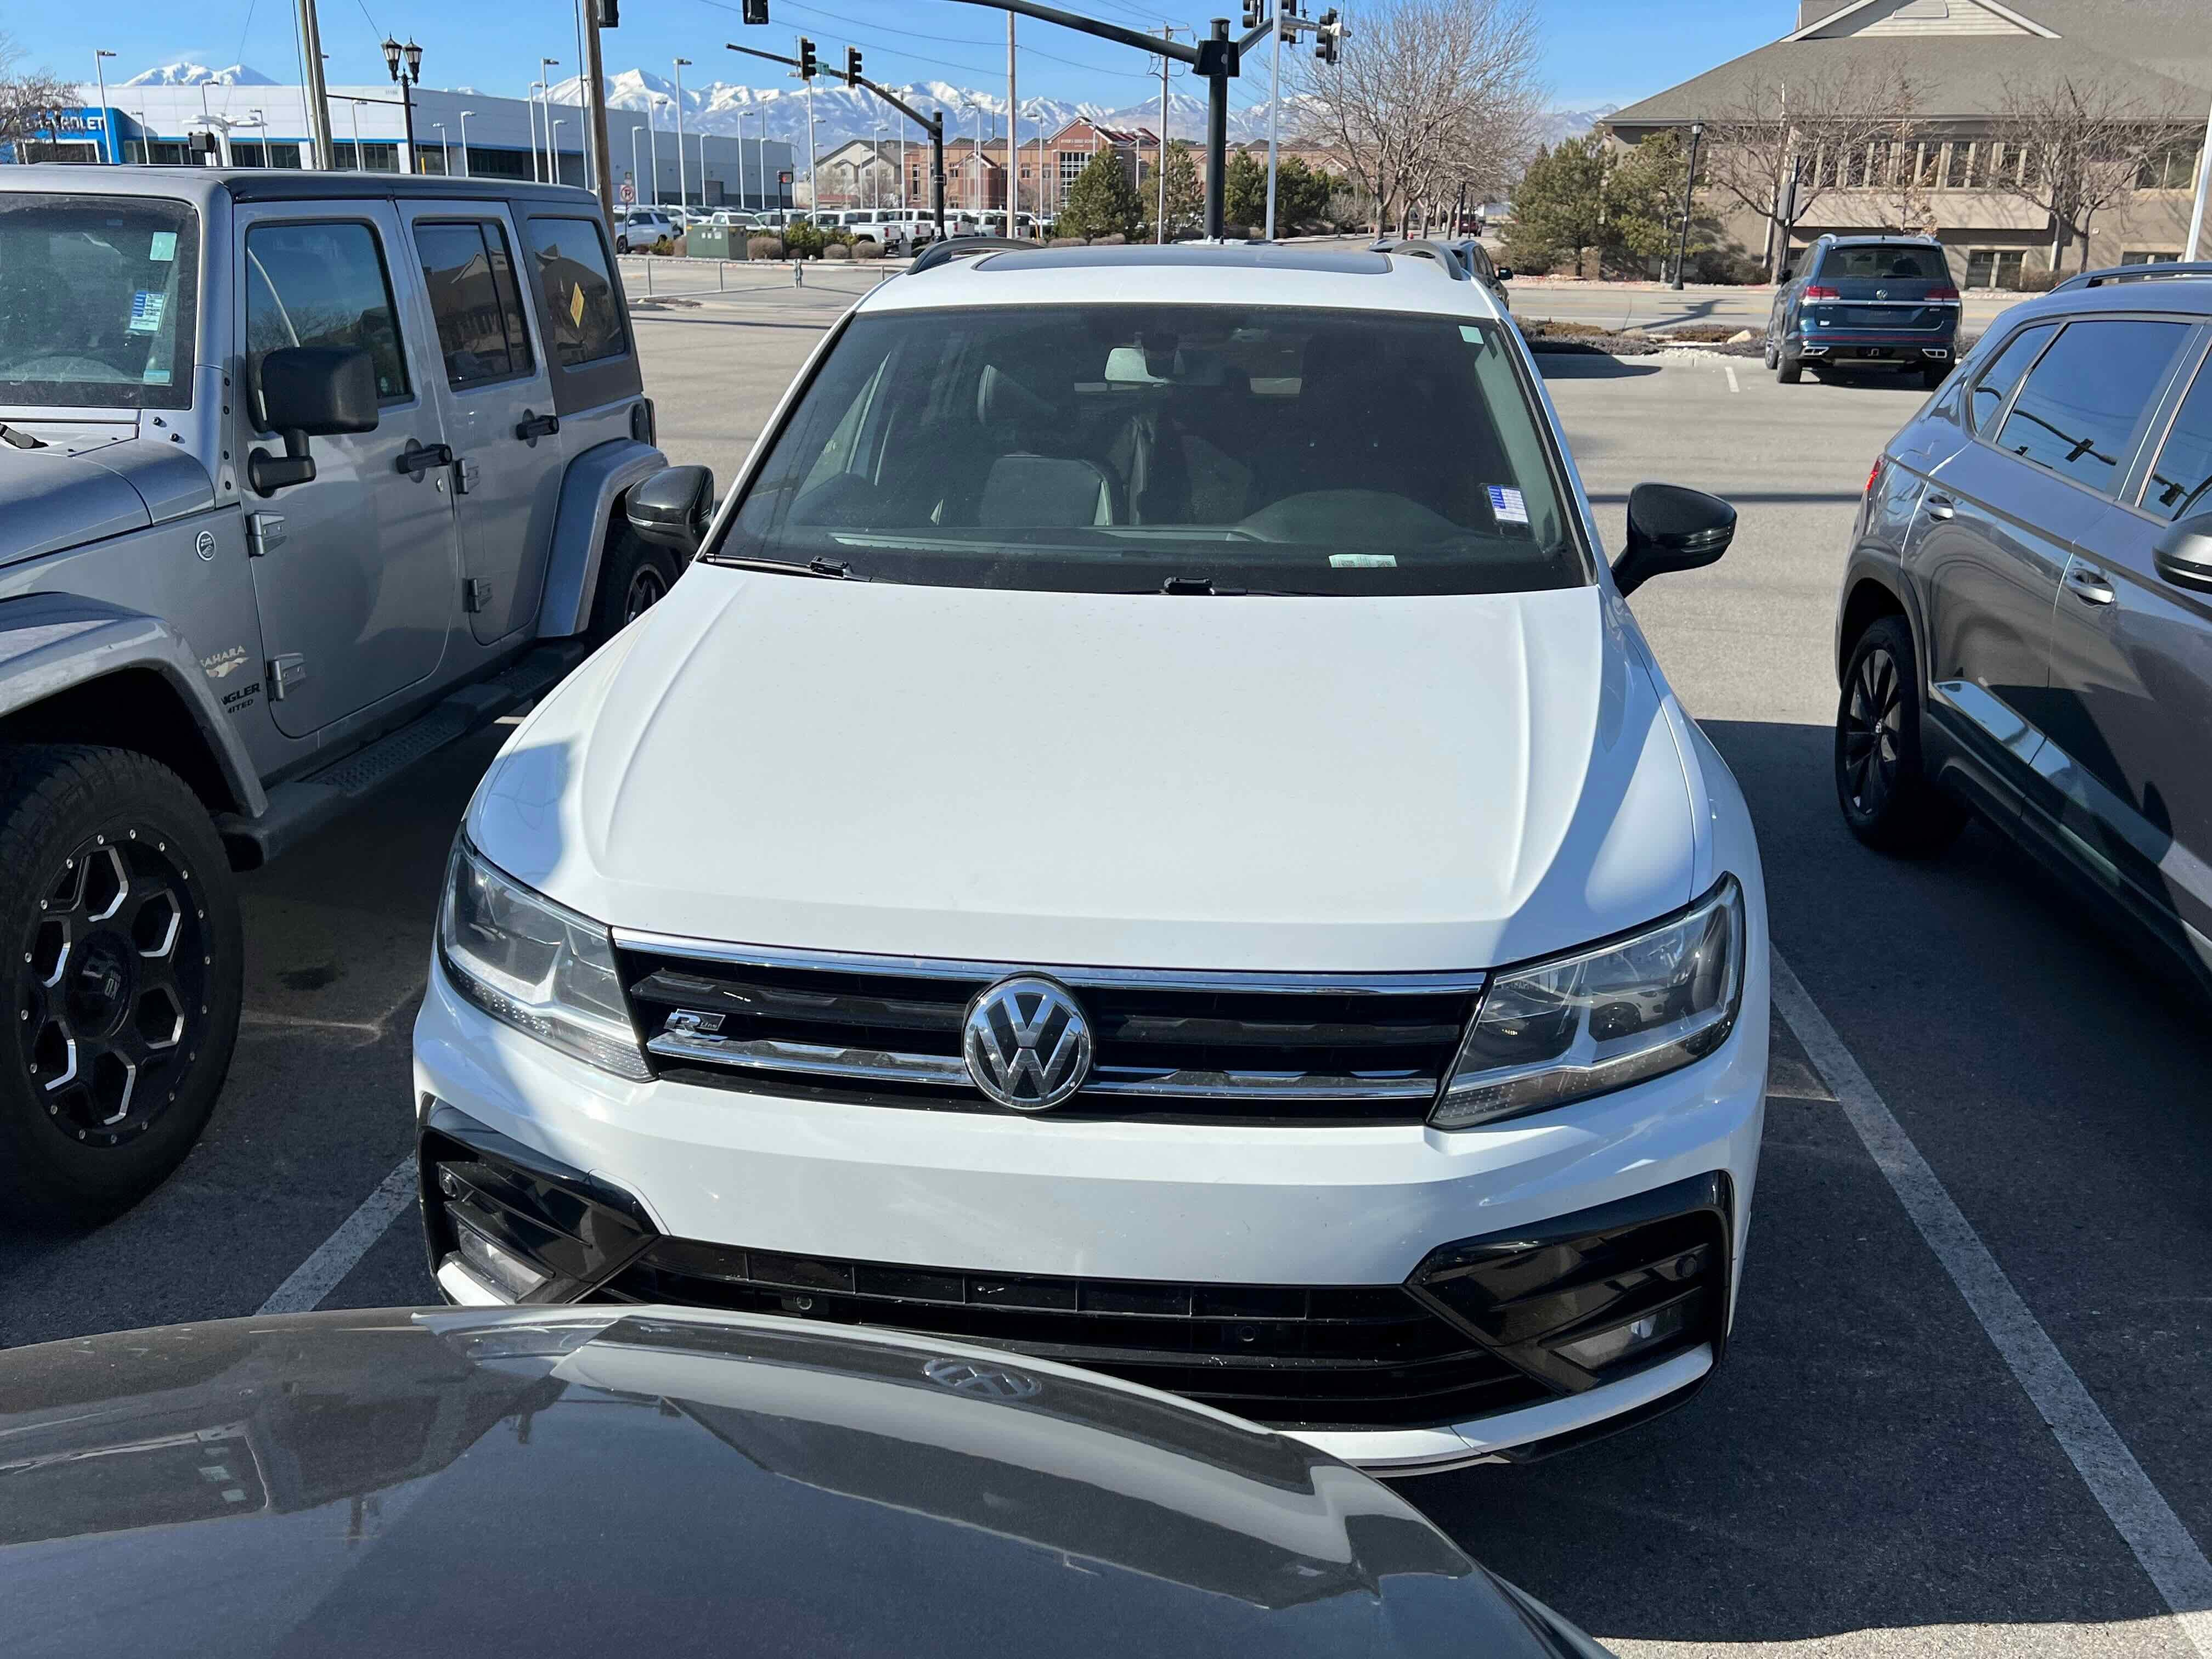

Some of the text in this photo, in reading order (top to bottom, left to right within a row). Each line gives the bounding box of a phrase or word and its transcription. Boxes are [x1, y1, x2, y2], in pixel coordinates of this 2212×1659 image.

[221, 682, 261, 706] NGLER
[663, 1012, 701, 1031] R
[969, 980, 1085, 1105] VW
